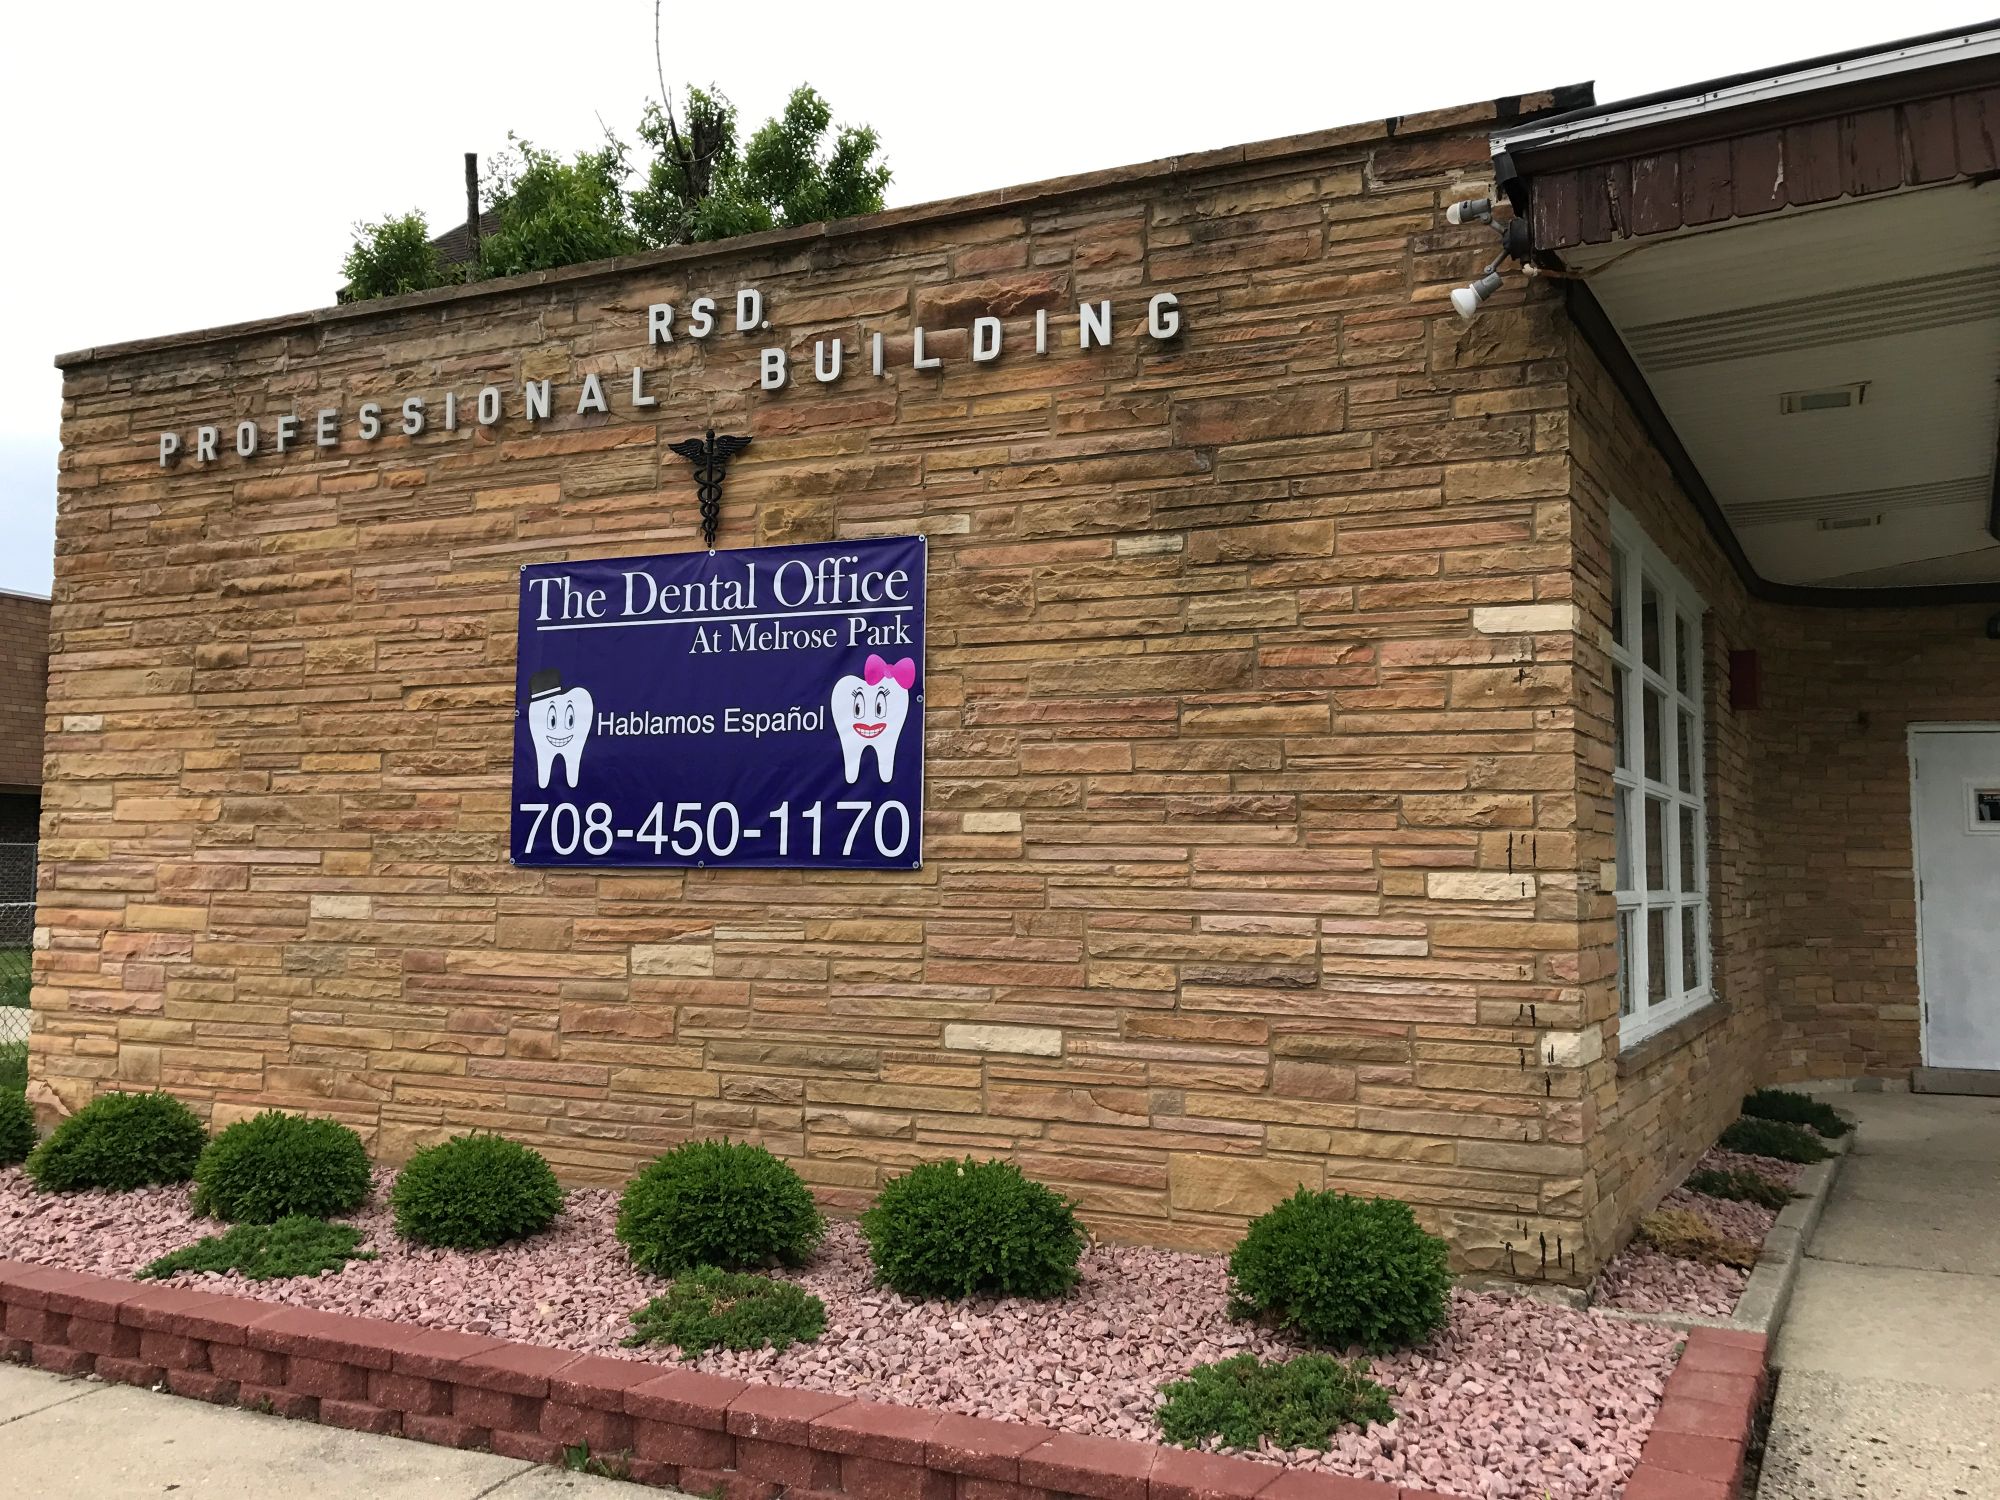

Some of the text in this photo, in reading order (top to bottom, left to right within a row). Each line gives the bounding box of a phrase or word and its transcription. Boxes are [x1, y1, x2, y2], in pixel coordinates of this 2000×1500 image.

[648, 288, 770, 346] RSD.
[159, 292, 1180, 468] PROFESSIONAL BUILDING
[528, 555, 911, 622] The Dental Office
[688, 611, 914, 655] At Melrose Park
[597, 705, 825, 739] Hablamos Español
[519, 800, 911, 858] 708-450-1170
